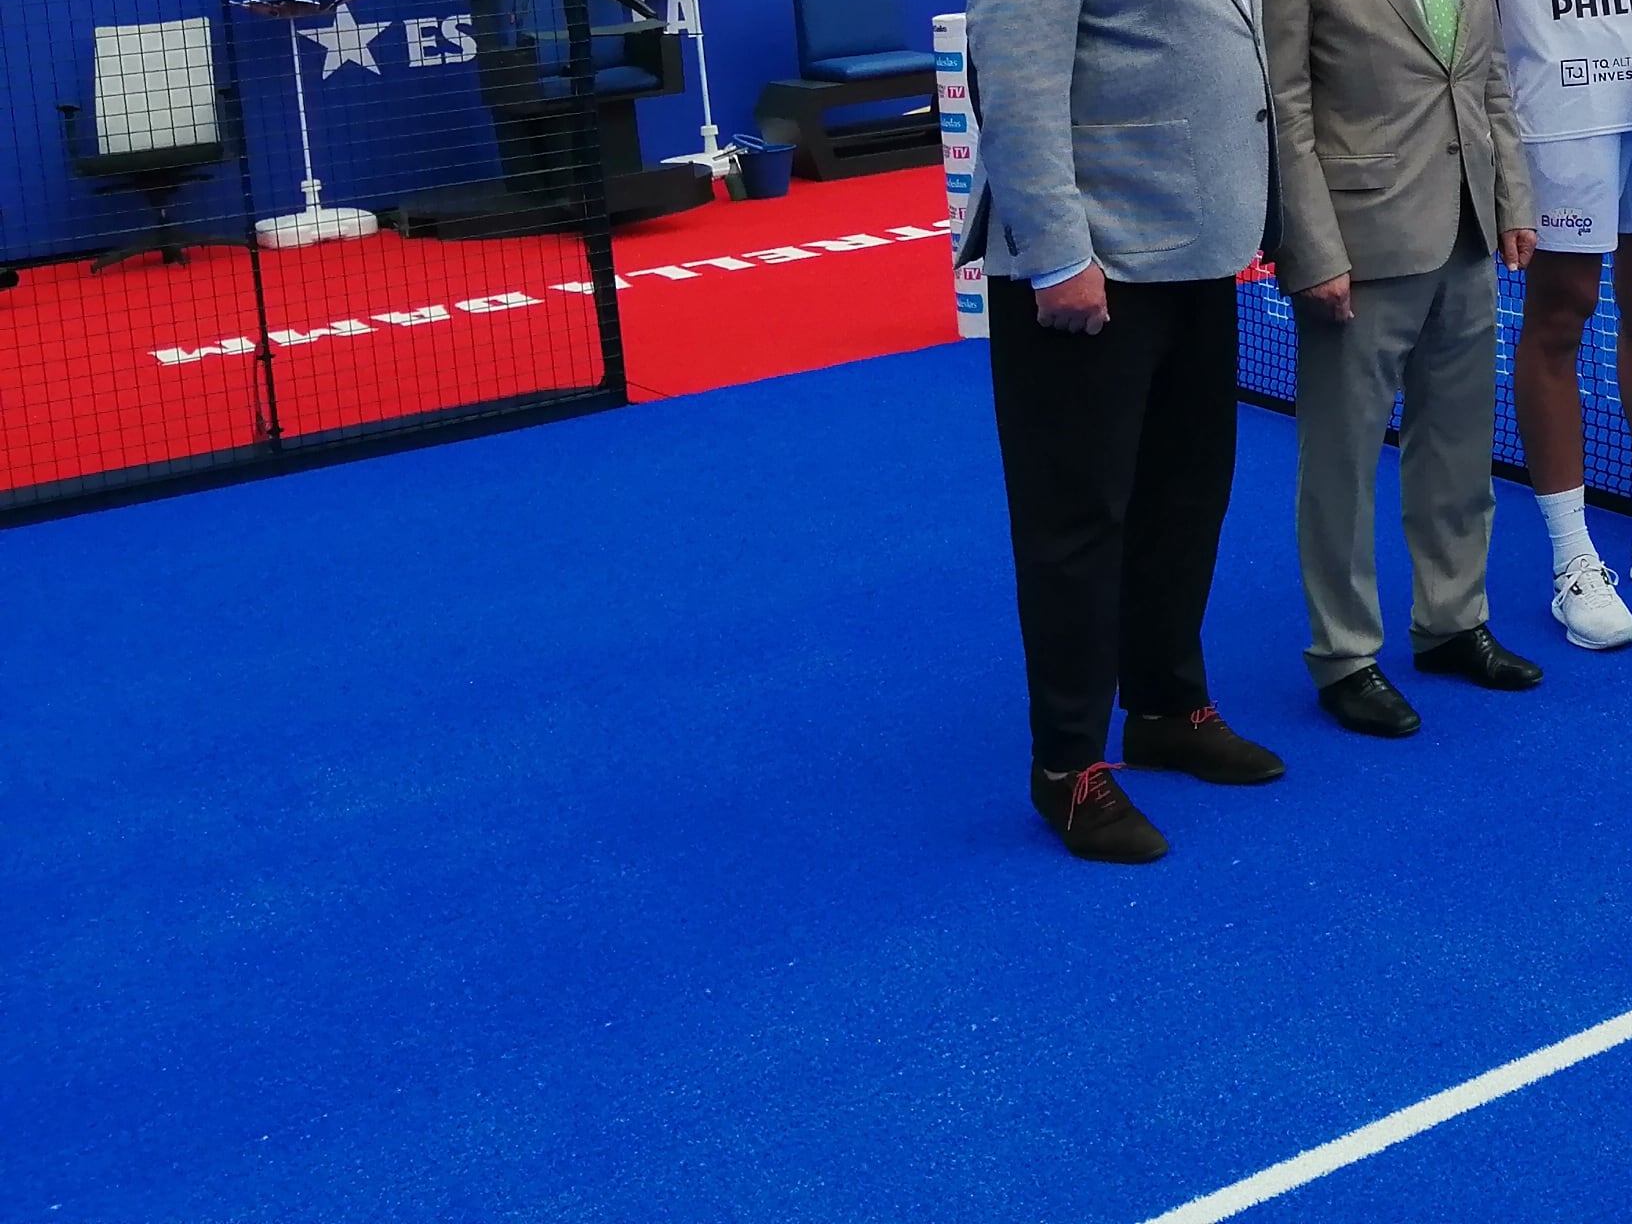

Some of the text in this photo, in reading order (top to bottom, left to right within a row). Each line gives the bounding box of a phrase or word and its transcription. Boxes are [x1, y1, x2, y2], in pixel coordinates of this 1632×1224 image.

[1592, 59, 1610, 70] TQ
[948, 86, 964, 98] TV
[953, 147, 969, 159] TV
[1541, 214, 1593, 228] Buraco
[965, 268, 981, 281] TV
